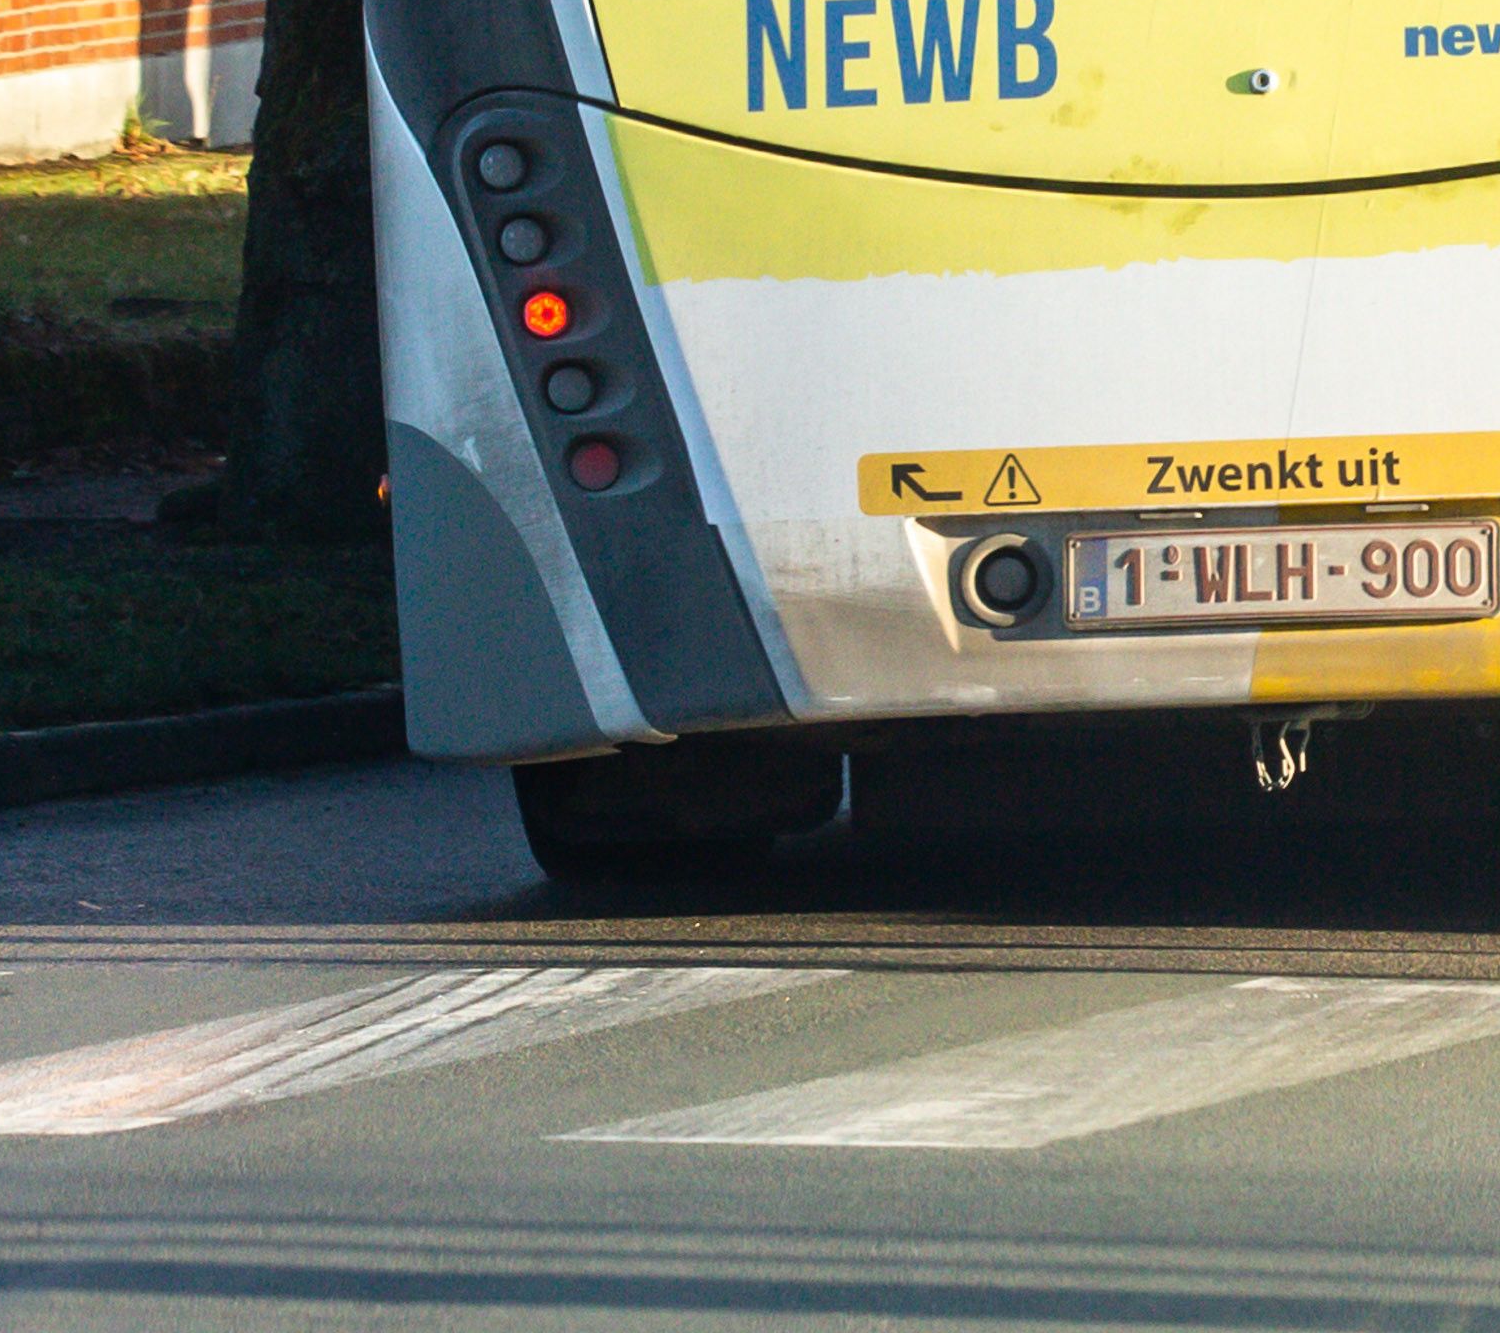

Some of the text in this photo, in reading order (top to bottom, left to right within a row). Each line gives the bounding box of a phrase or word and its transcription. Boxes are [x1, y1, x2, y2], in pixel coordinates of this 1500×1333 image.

[1147, 448, 1400, 495] Zwenkt uit
[1079, 586, 1102, 614] B
